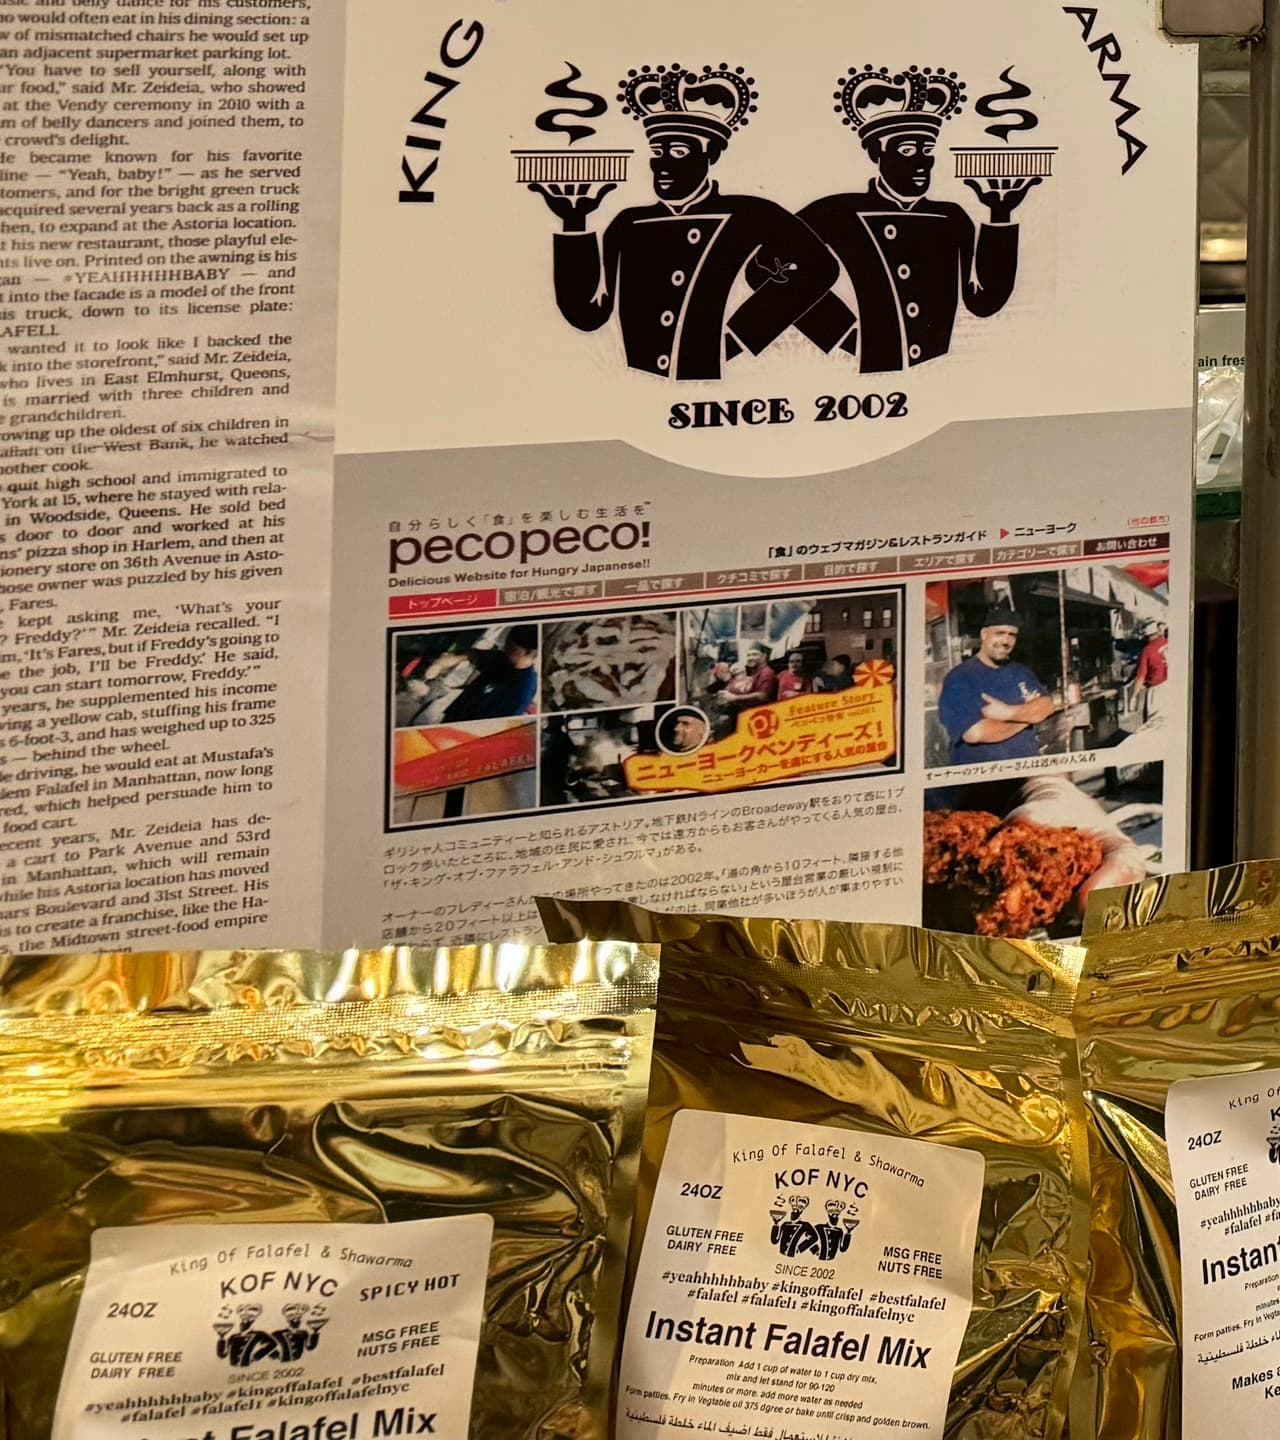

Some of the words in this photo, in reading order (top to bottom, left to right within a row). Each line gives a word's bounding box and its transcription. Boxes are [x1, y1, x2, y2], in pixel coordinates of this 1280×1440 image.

[398, 17, 486, 204] KING
[104, 372, 139, 386] East
[146, 369, 223, 384] Elmhurst,
[230, 366, 291, 382] Queens,
[668, 397, 796, 430] SINCE
[814, 391, 908, 423] 2002
[1014, 522, 1077, 537] ニューヨーク
[389, 574, 451, 588] Delicious
[454, 570, 508, 584] Website
[510, 568, 529, 579] for
[532, 565, 579, 579] Hungry
[581, 559, 651, 575] Japanese!!
[774, 1168, 820, 1189] KOF
[826, 1170, 869, 1199] NYC
[645, 1311, 757, 1350] Instant
[764, 1323, 869, 1363] Falafel
[878, 1336, 932, 1369] Mix
